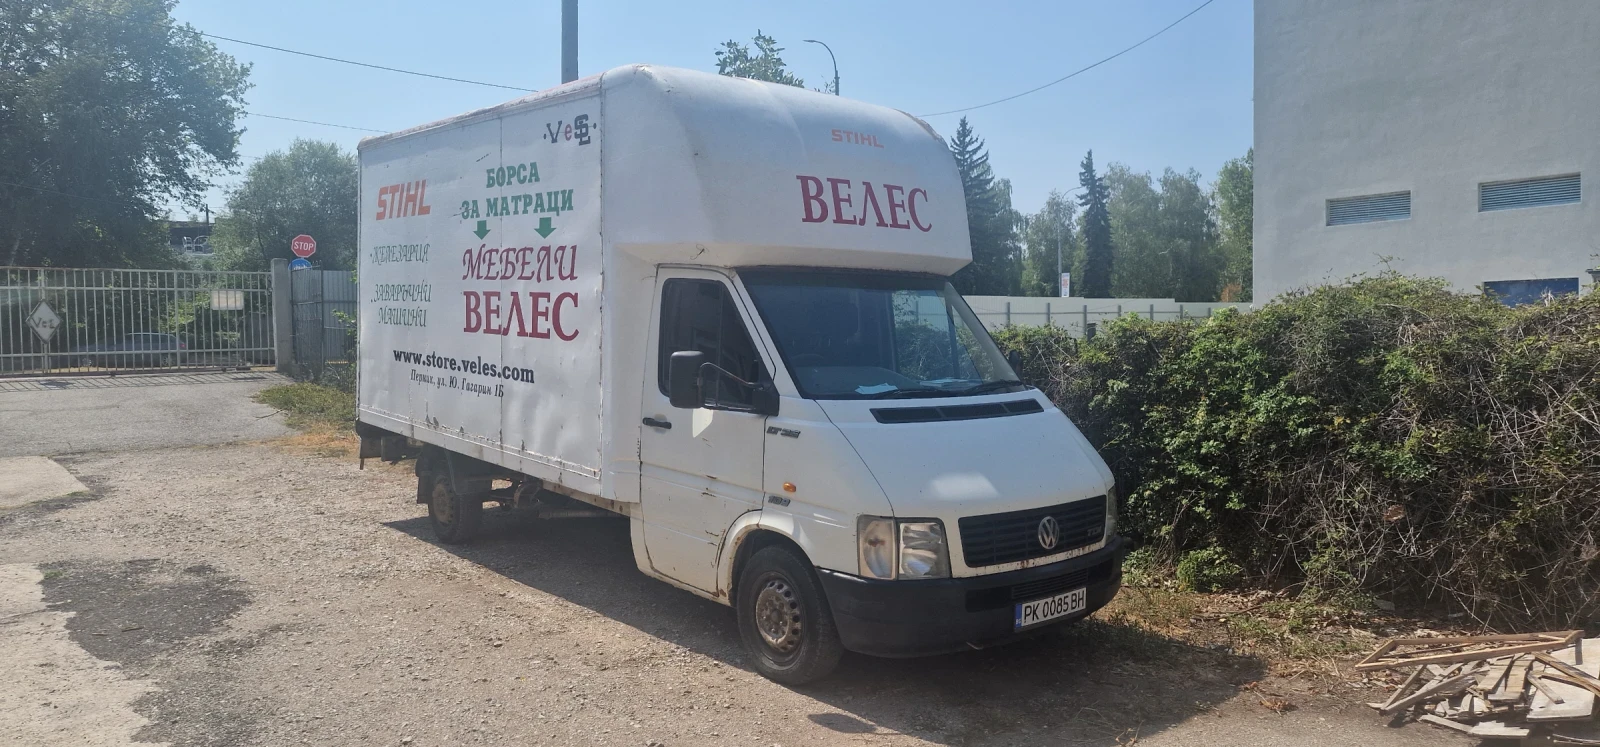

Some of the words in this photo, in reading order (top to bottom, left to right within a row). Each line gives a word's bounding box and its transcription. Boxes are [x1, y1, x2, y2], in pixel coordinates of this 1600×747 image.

[831, 129, 885, 149] STIHL
[486, 161, 540, 189] БОРСА
[375, 179, 431, 221] STIHL
[461, 200, 480, 220] ЗА
[486, 189, 574, 217] МАТРАЦИ
[796, 175, 933, 233] ВЕЛЕС
[293, 241, 314, 251] STOP
[462, 243, 579, 284] МЕБЕЛИ
[463, 291, 580, 342] ВЕЛЕС
[393, 349, 535, 384] www.store.veles.com
